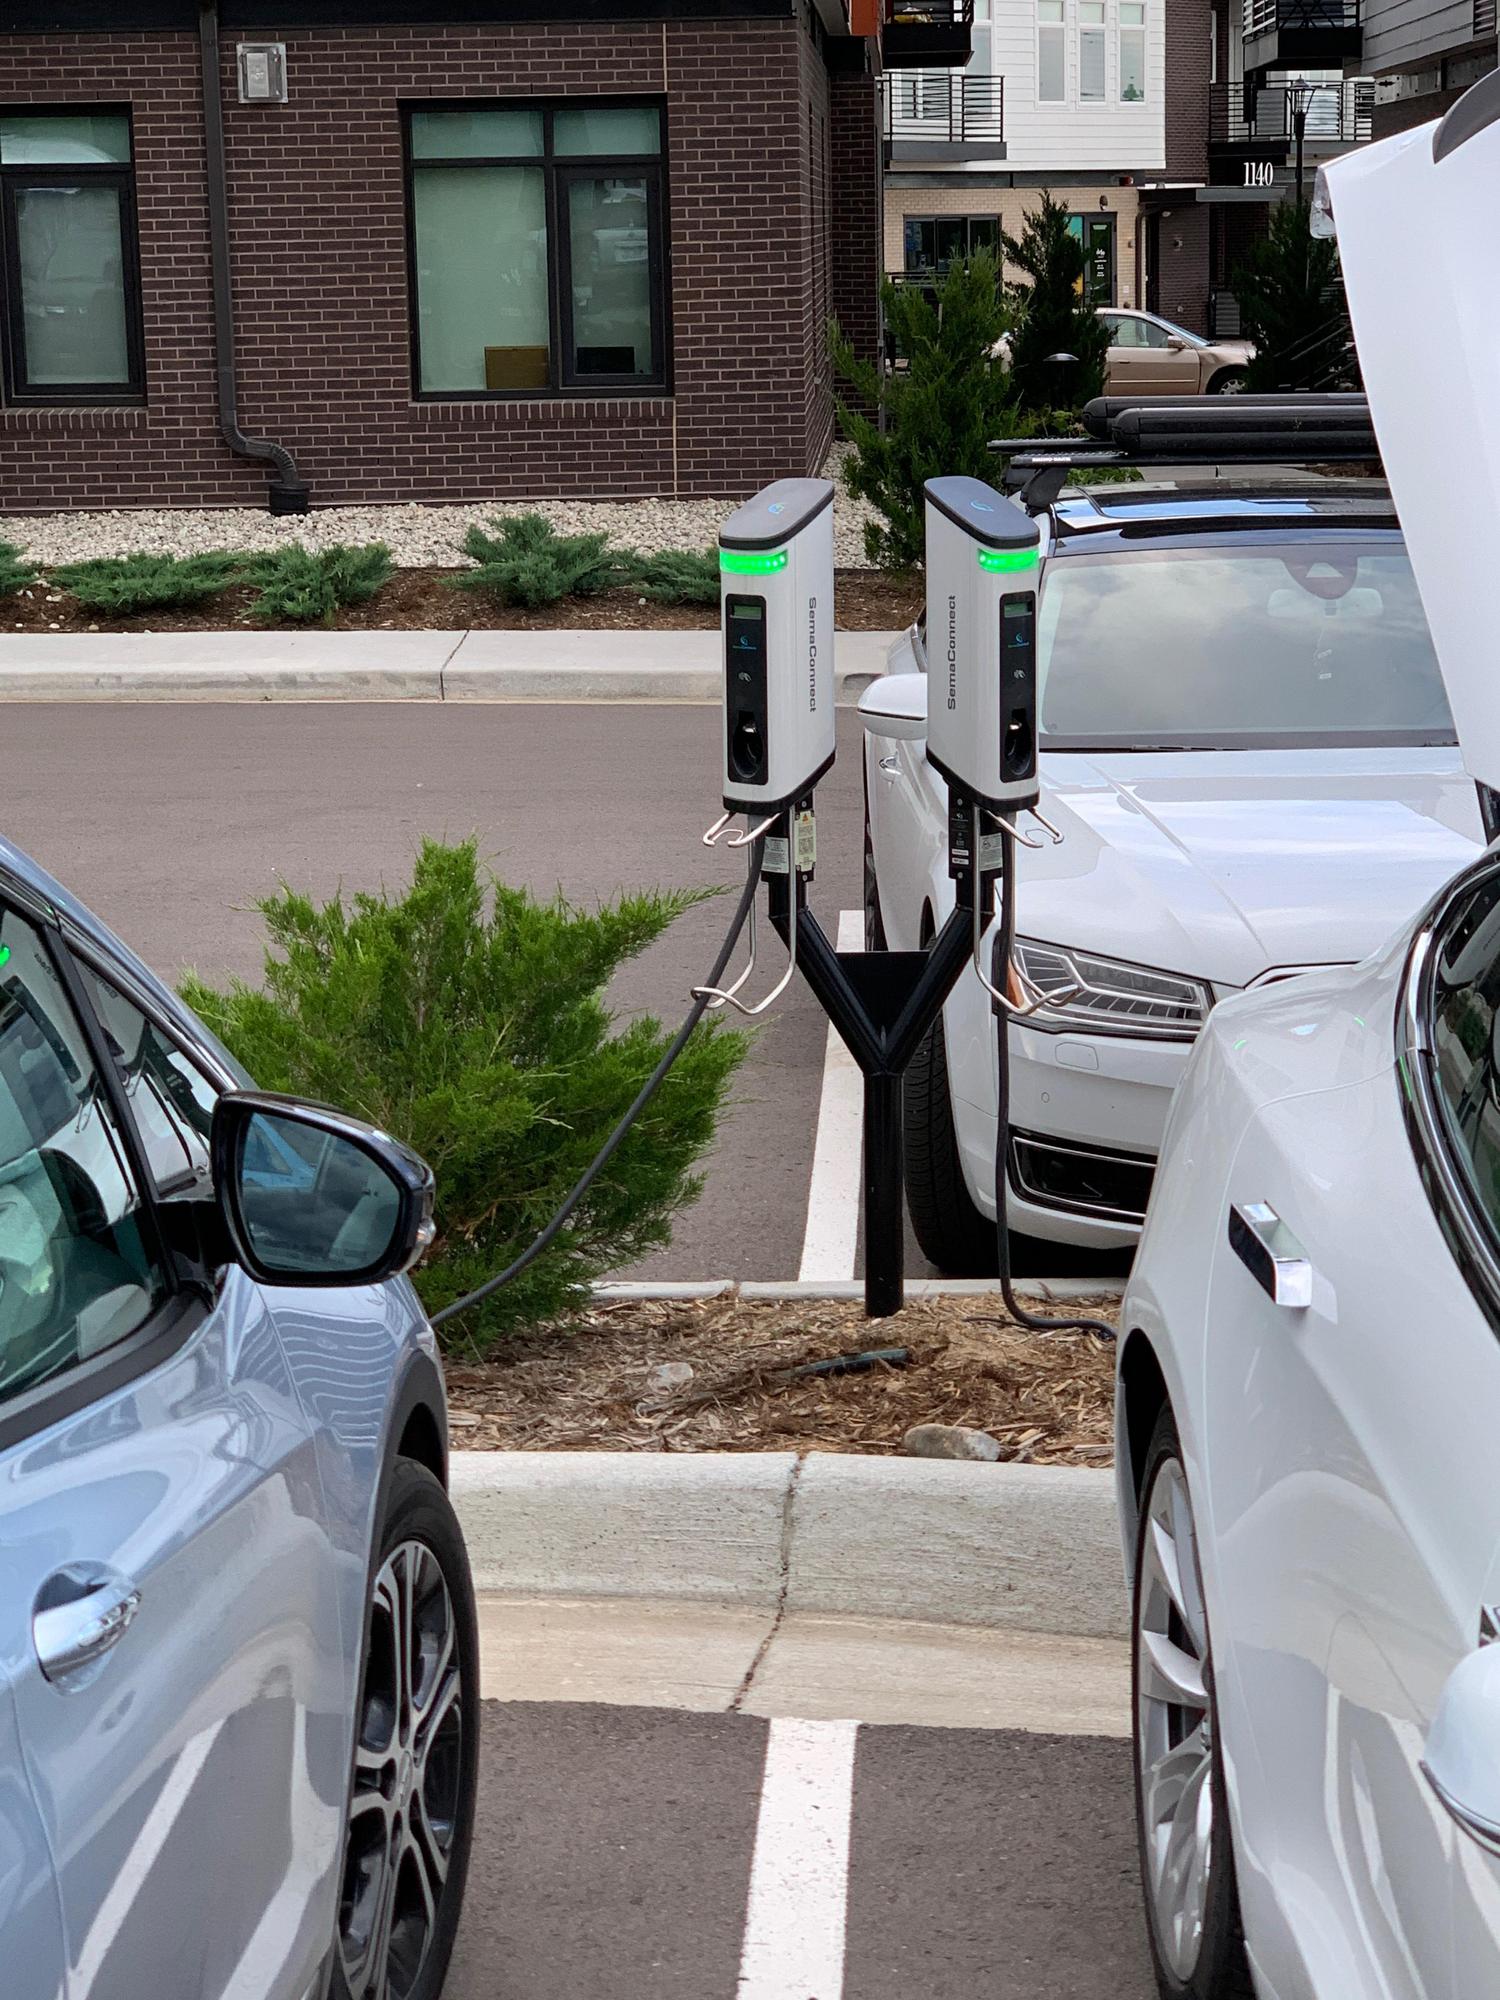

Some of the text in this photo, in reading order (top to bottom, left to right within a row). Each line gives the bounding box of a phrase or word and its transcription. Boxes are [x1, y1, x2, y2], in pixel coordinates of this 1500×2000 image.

[1243, 162, 1274, 186] 1140
[808, 596, 817, 713] SemaConnect
[947, 594, 956, 711] SemaConnect
